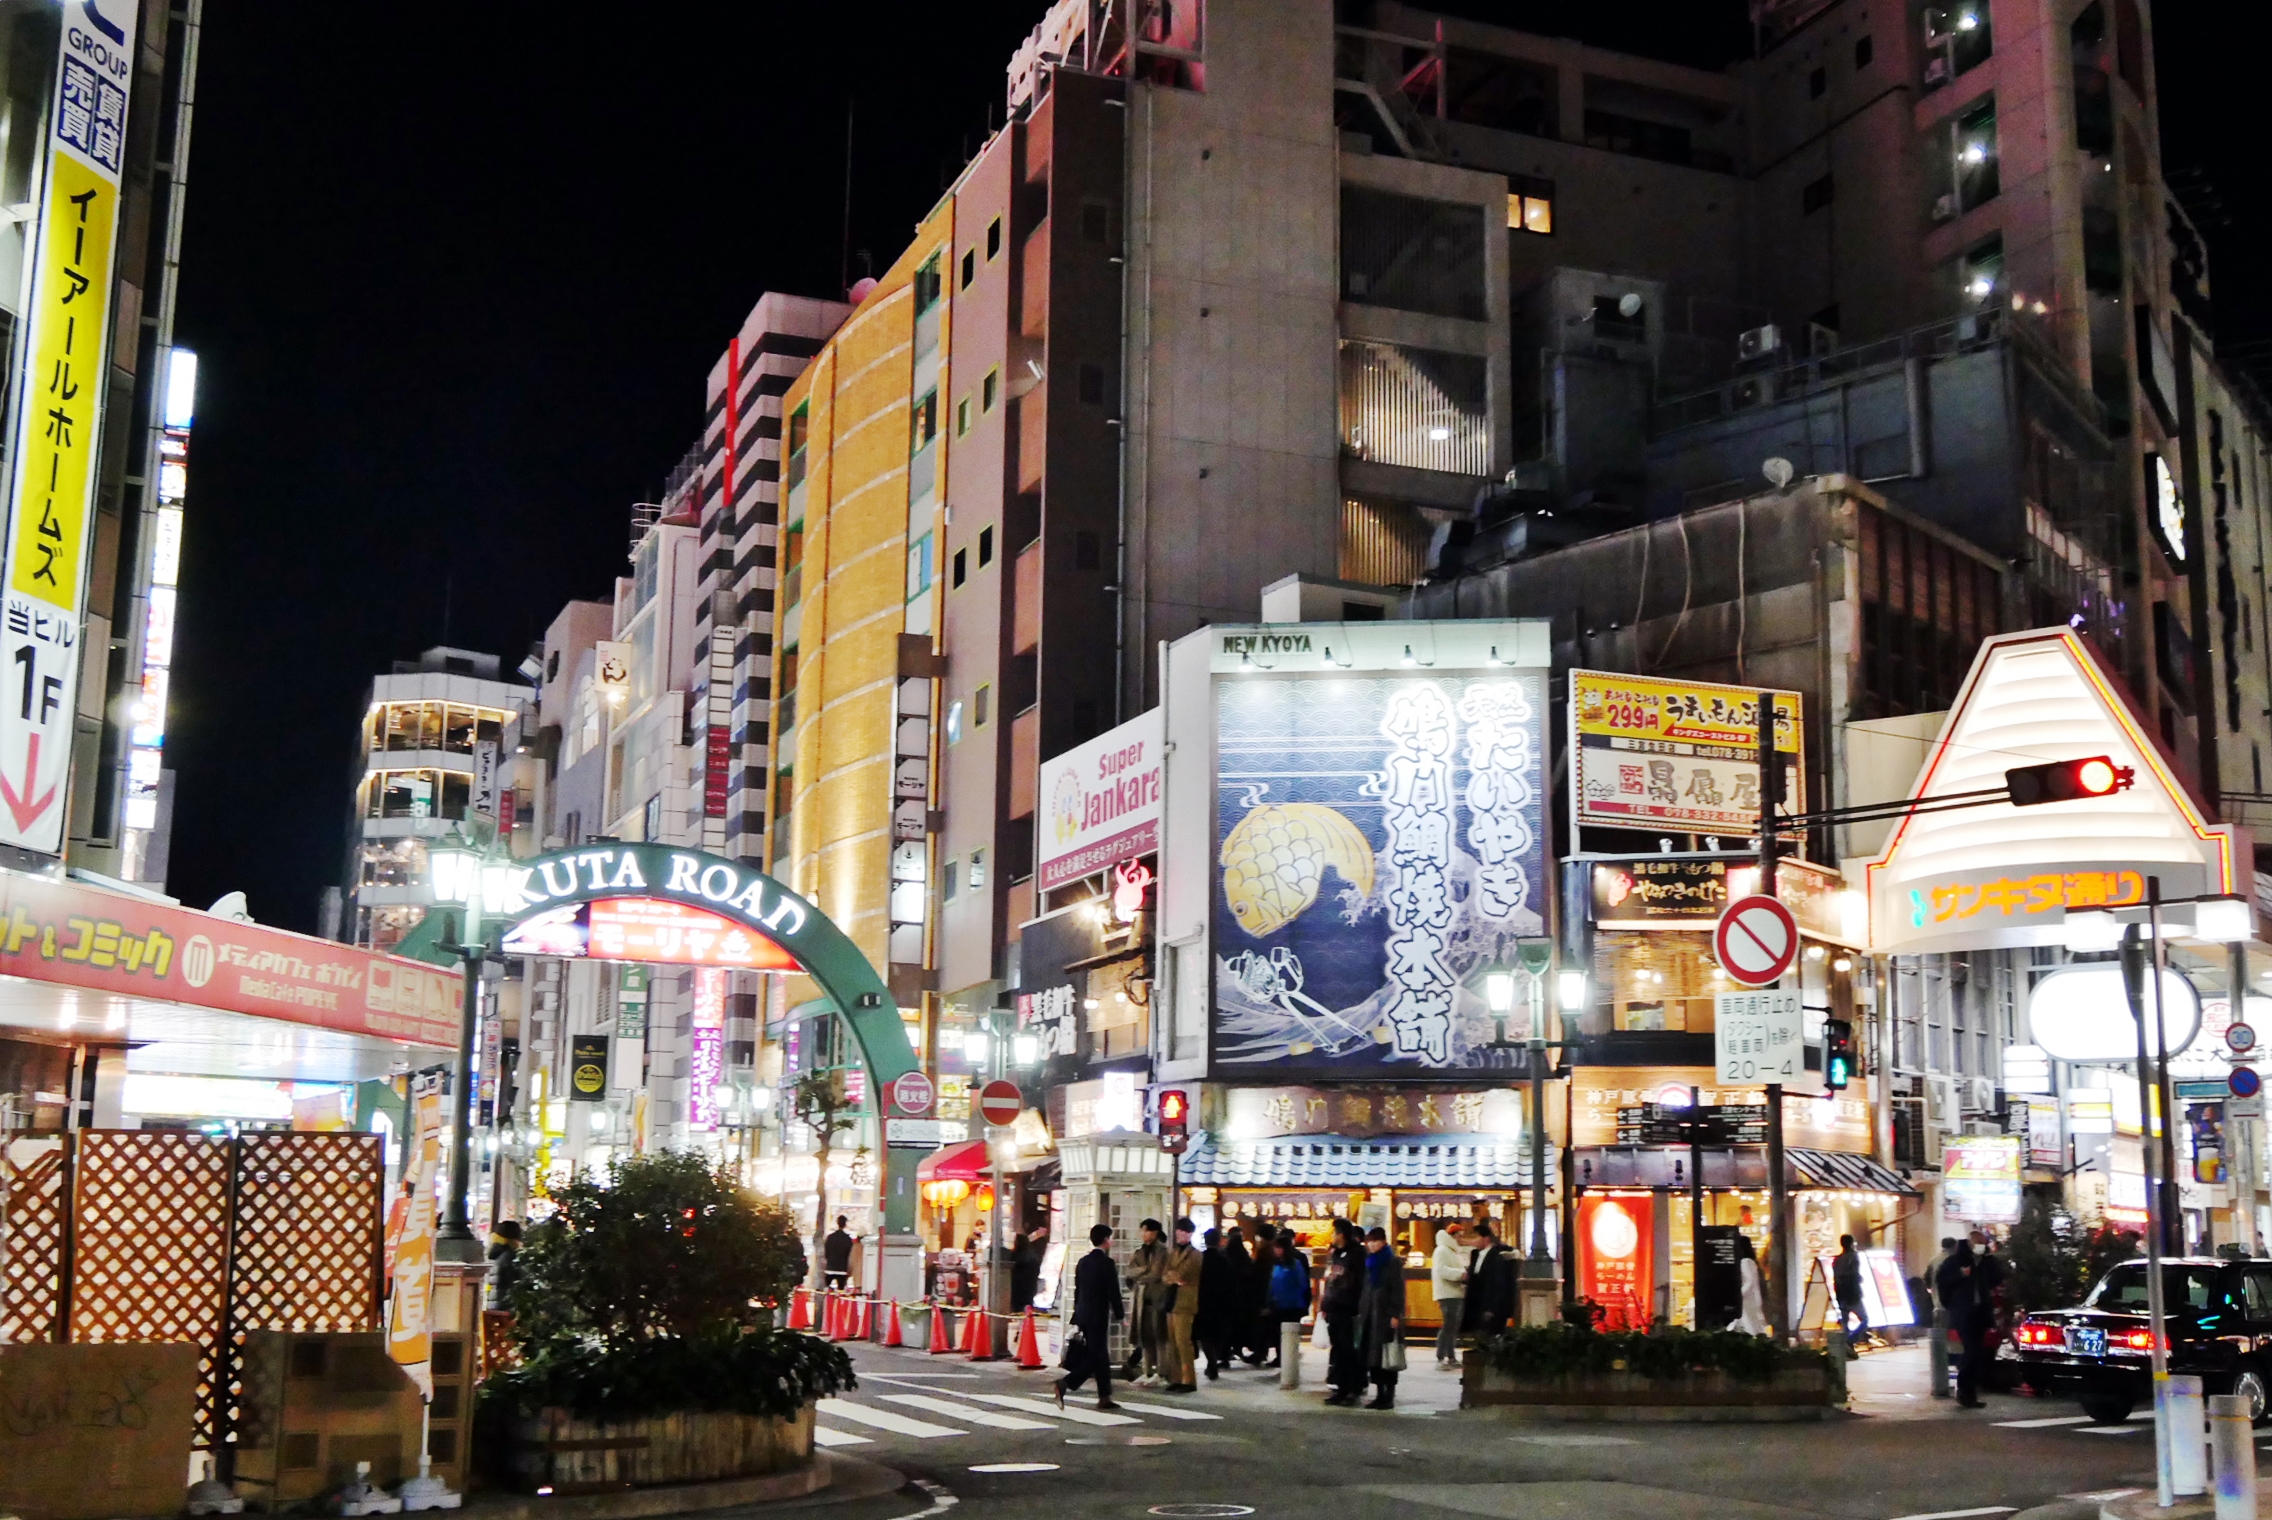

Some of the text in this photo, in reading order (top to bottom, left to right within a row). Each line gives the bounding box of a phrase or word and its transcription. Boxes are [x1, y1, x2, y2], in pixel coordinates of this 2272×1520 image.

[68, 27, 128, 79] GROUP
[59, 64, 94, 150] 売買
[93, 81, 125, 171] 賃貸
[33, 188, 97, 587] イーアールホームズ
[8, 601, 76, 649] 当ビル
[1223, 634, 1312, 653] NEW KYOYA
[15, 644, 63, 725] 1F
[1607, 704, 1659, 730] 299円
[1099, 739, 1145, 780] Super
[1081, 766, 1160, 832] Jankara
[1628, 804, 1654, 815] TEL
[665, 854, 807, 936] ROAD
[1931, 870, 2145, 923] サンキタ通り
[41, 925, 56, 958] &
[61, 917, 174, 977] コミック
[593, 923, 716, 960] モーリヤ
[1721, 995, 1797, 1015] 車両通行止め
